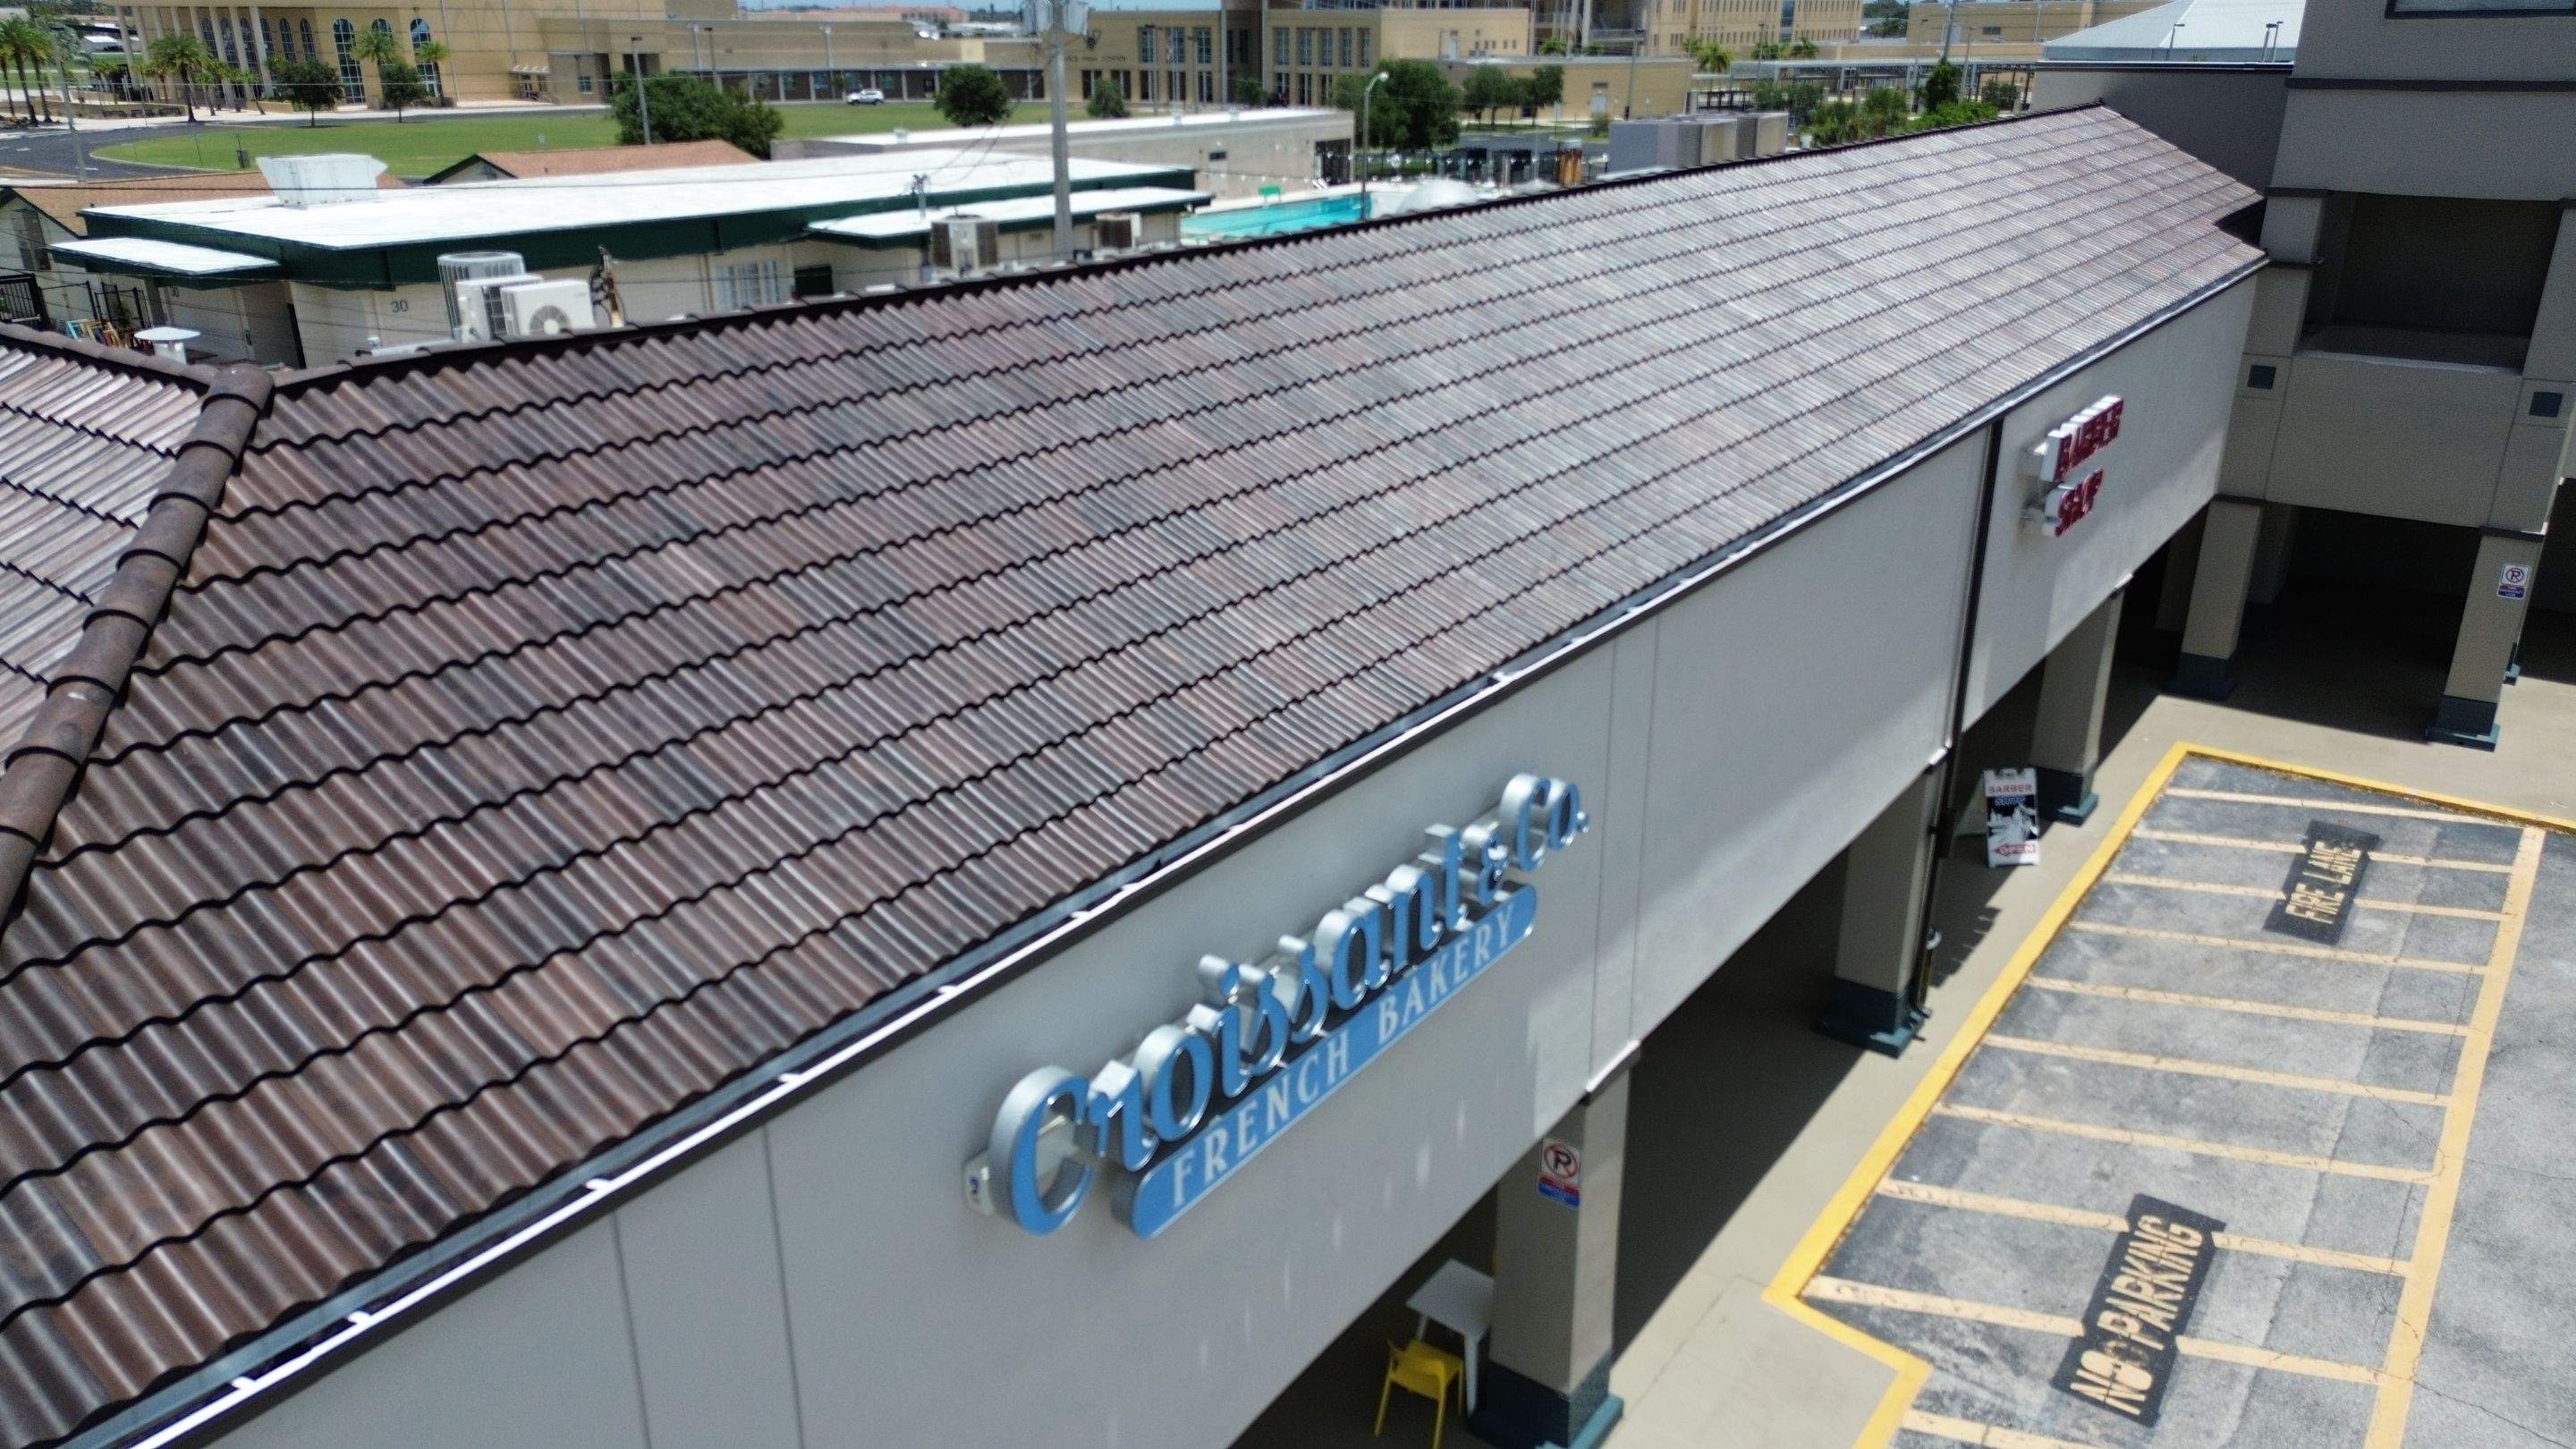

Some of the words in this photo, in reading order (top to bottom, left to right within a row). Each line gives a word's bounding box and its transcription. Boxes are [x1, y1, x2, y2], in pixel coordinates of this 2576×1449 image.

[391, 300, 408, 313] 30
[1988, 784, 2032, 795] BARBER
[1995, 794, 2026, 806] SHOP
[2285, 882, 2345, 925] FIRE
[1005, 825, 1471, 1238] Croissant
[1172, 1029, 1351, 1209] FRENCH
[1377, 901, 1517, 1046] BAKERY
[2097, 1214, 2204, 1352] PARKING
[2069, 1350, 2153, 1416] NO
